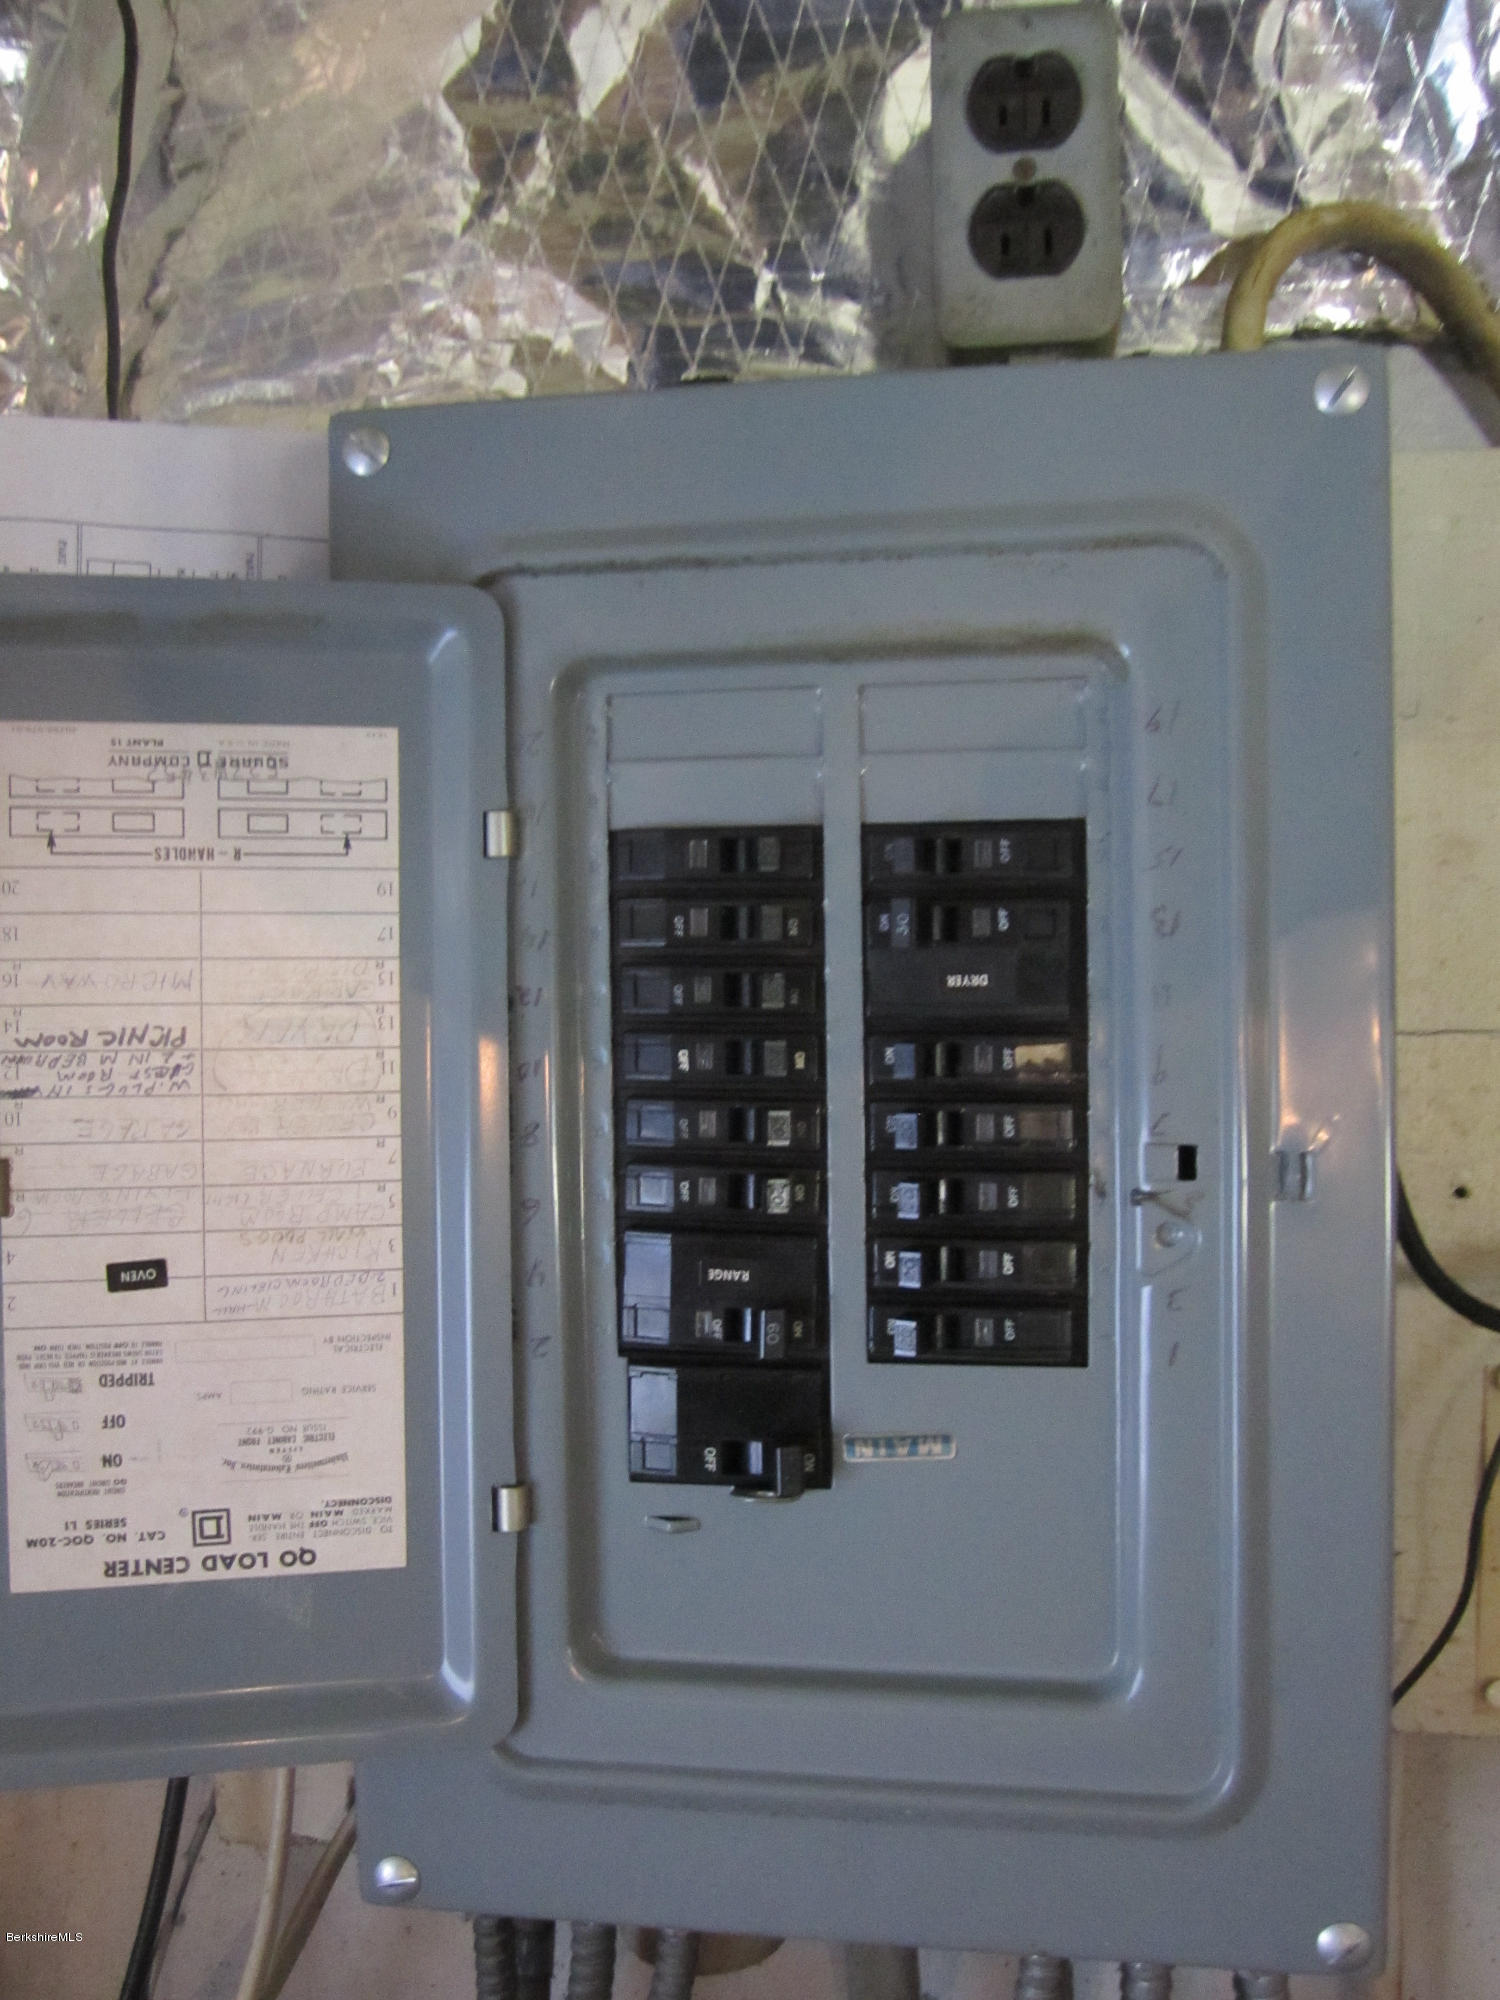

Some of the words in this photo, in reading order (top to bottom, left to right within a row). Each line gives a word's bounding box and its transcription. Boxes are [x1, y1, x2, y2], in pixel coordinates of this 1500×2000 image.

[125, 737, 165, 748] PLANT
[107, 754, 191, 768] COMPANY
[216, 755, 289, 769] SQUARE
[153, 846, 216, 862] HANDLES
[999, 838, 1011, 865] OFF
[1, 880, 21, 895] 20
[376, 881, 395, 897] 19
[673, 915, 684, 937] OFF
[997, 907, 1010, 933] OFF
[1, 926, 20, 942] 18
[376, 926, 395, 942] 17
[1, 973, 19, 988] 16
[376, 971, 395, 987] 15
[946, 973, 989, 988] DRYER
[672, 984, 684, 1006] OFF
[4, 1019, 20, 1034] 14
[375, 1015, 395, 1031] 13
[13, 1028, 89, 1049] ROOM
[97, 1022, 187, 1048] PICNIC
[677, 1049, 690, 1073] OFF
[1002, 1047, 1014, 1070] OFF
[381, 1060, 395, 1075] 11
[4, 1111, 21, 1127] 10
[386, 1106, 398, 1120] 9
[1002, 1115, 1016, 1139] OFF
[387, 1150, 398, 1165] 7
[679, 1180, 690, 1202] OFF
[1007, 1185, 1019, 1208] OFF
[387, 1238, 396, 1254] 3
[5, 1250, 17, 1266] 4
[884, 1250, 896, 1270] ON
[1002, 1252, 1014, 1276] OFF
[120, 1267, 157, 1284] OVEN
[707, 1268, 750, 1283] RANGE
[5, 1296, 17, 1312] 2
[711, 1318, 723, 1340] OFF
[1004, 1318, 1016, 1342] OFF
[98, 1372, 155, 1388] TRIPPED
[101, 1414, 126, 1430] OFF
[101, 1453, 123, 1469] ON
[703, 1447, 717, 1473] OFF
[247, 1512, 282, 1522] MAIN
[309, 1509, 345, 1518] MAIN
[84, 1517, 127, 1530] SERIES
[308, 1519, 329, 1528] OFF
[25, 1534, 95, 1549] QOC-20M
[101, 1532, 127, 1545] NO.
[134, 1529, 166, 1542] CAT.
[201, 1552, 269, 1571] LOAD
[279, 1548, 317, 1567] QO
[102, 1556, 191, 1578] CENTER
